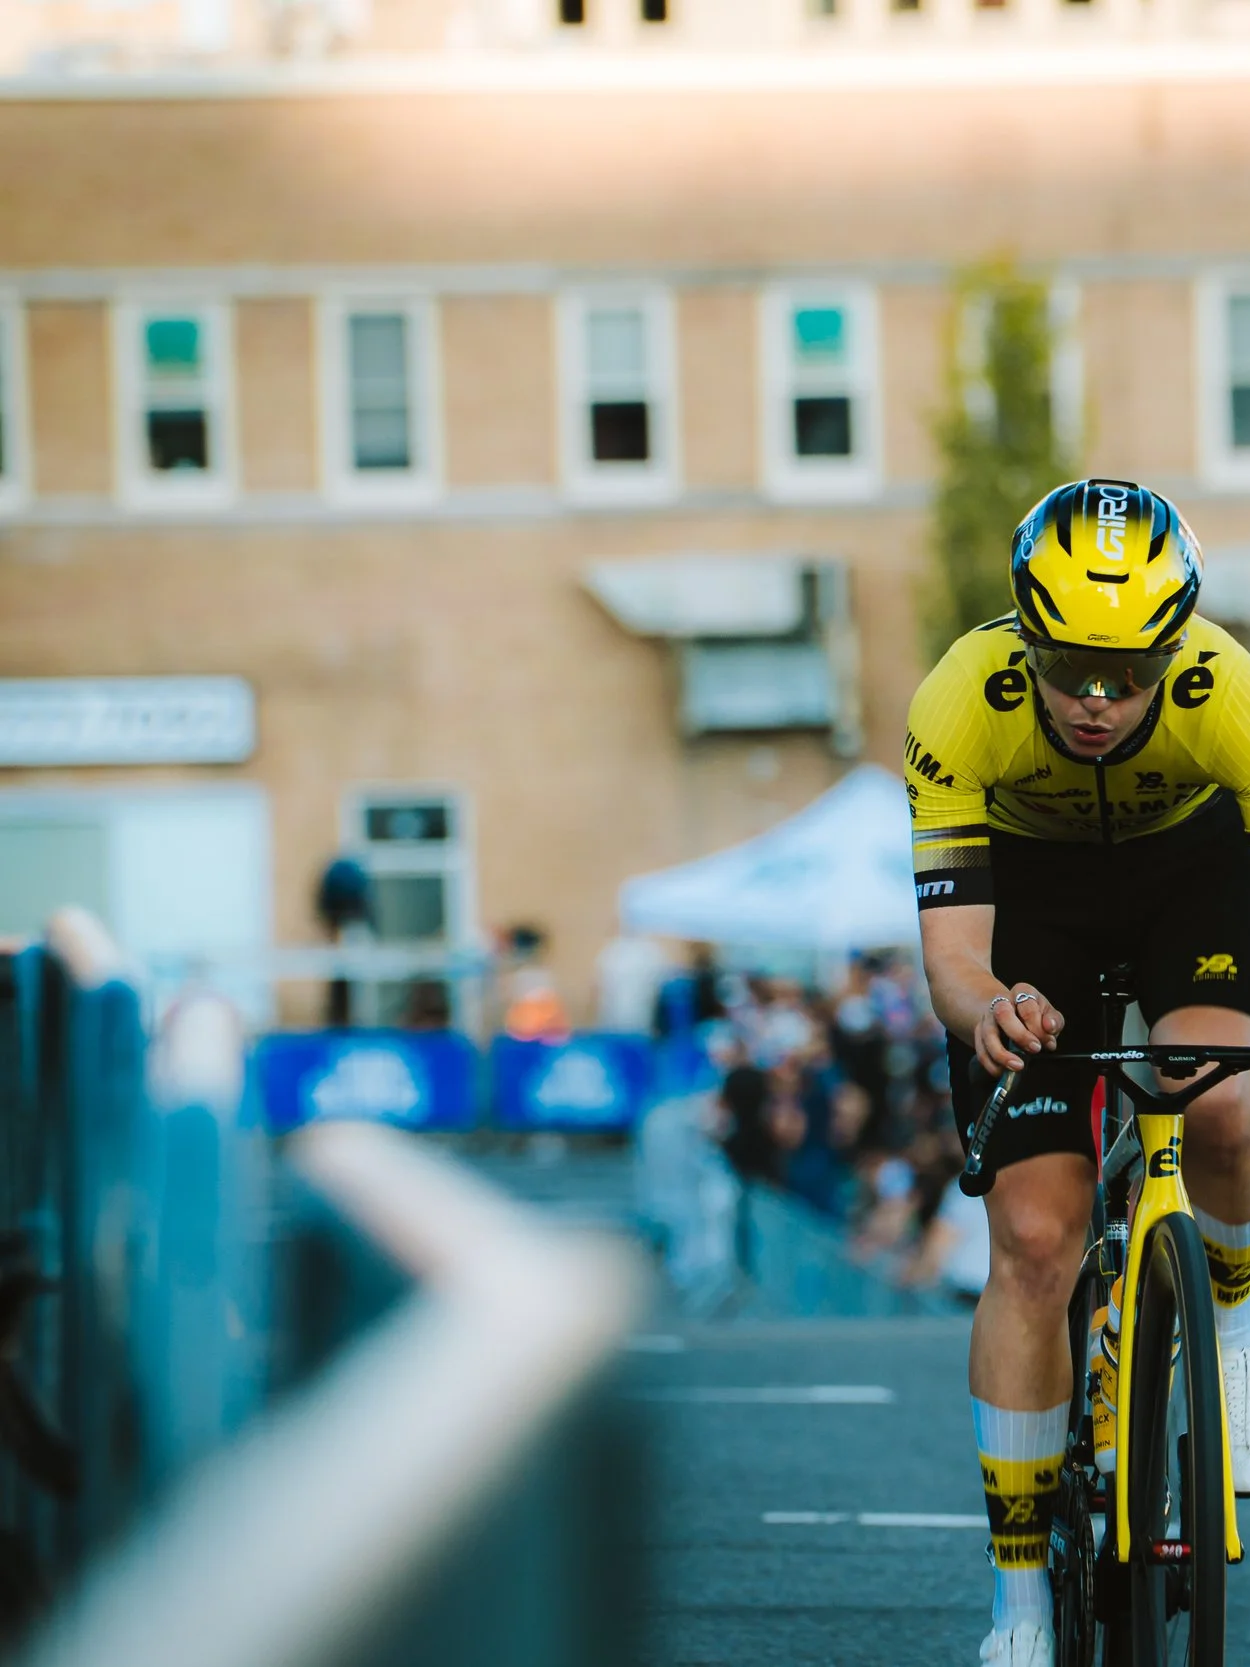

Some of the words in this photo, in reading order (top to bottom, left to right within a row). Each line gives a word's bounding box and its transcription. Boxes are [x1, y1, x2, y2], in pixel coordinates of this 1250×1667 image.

[1096, 487, 1128, 561] GIRO
[984, 651, 1027, 712] é
[1171, 651, 1220, 709] é
[1091, 1050, 1145, 1060] cervélo
[1149, 1136, 1182, 1178] é
